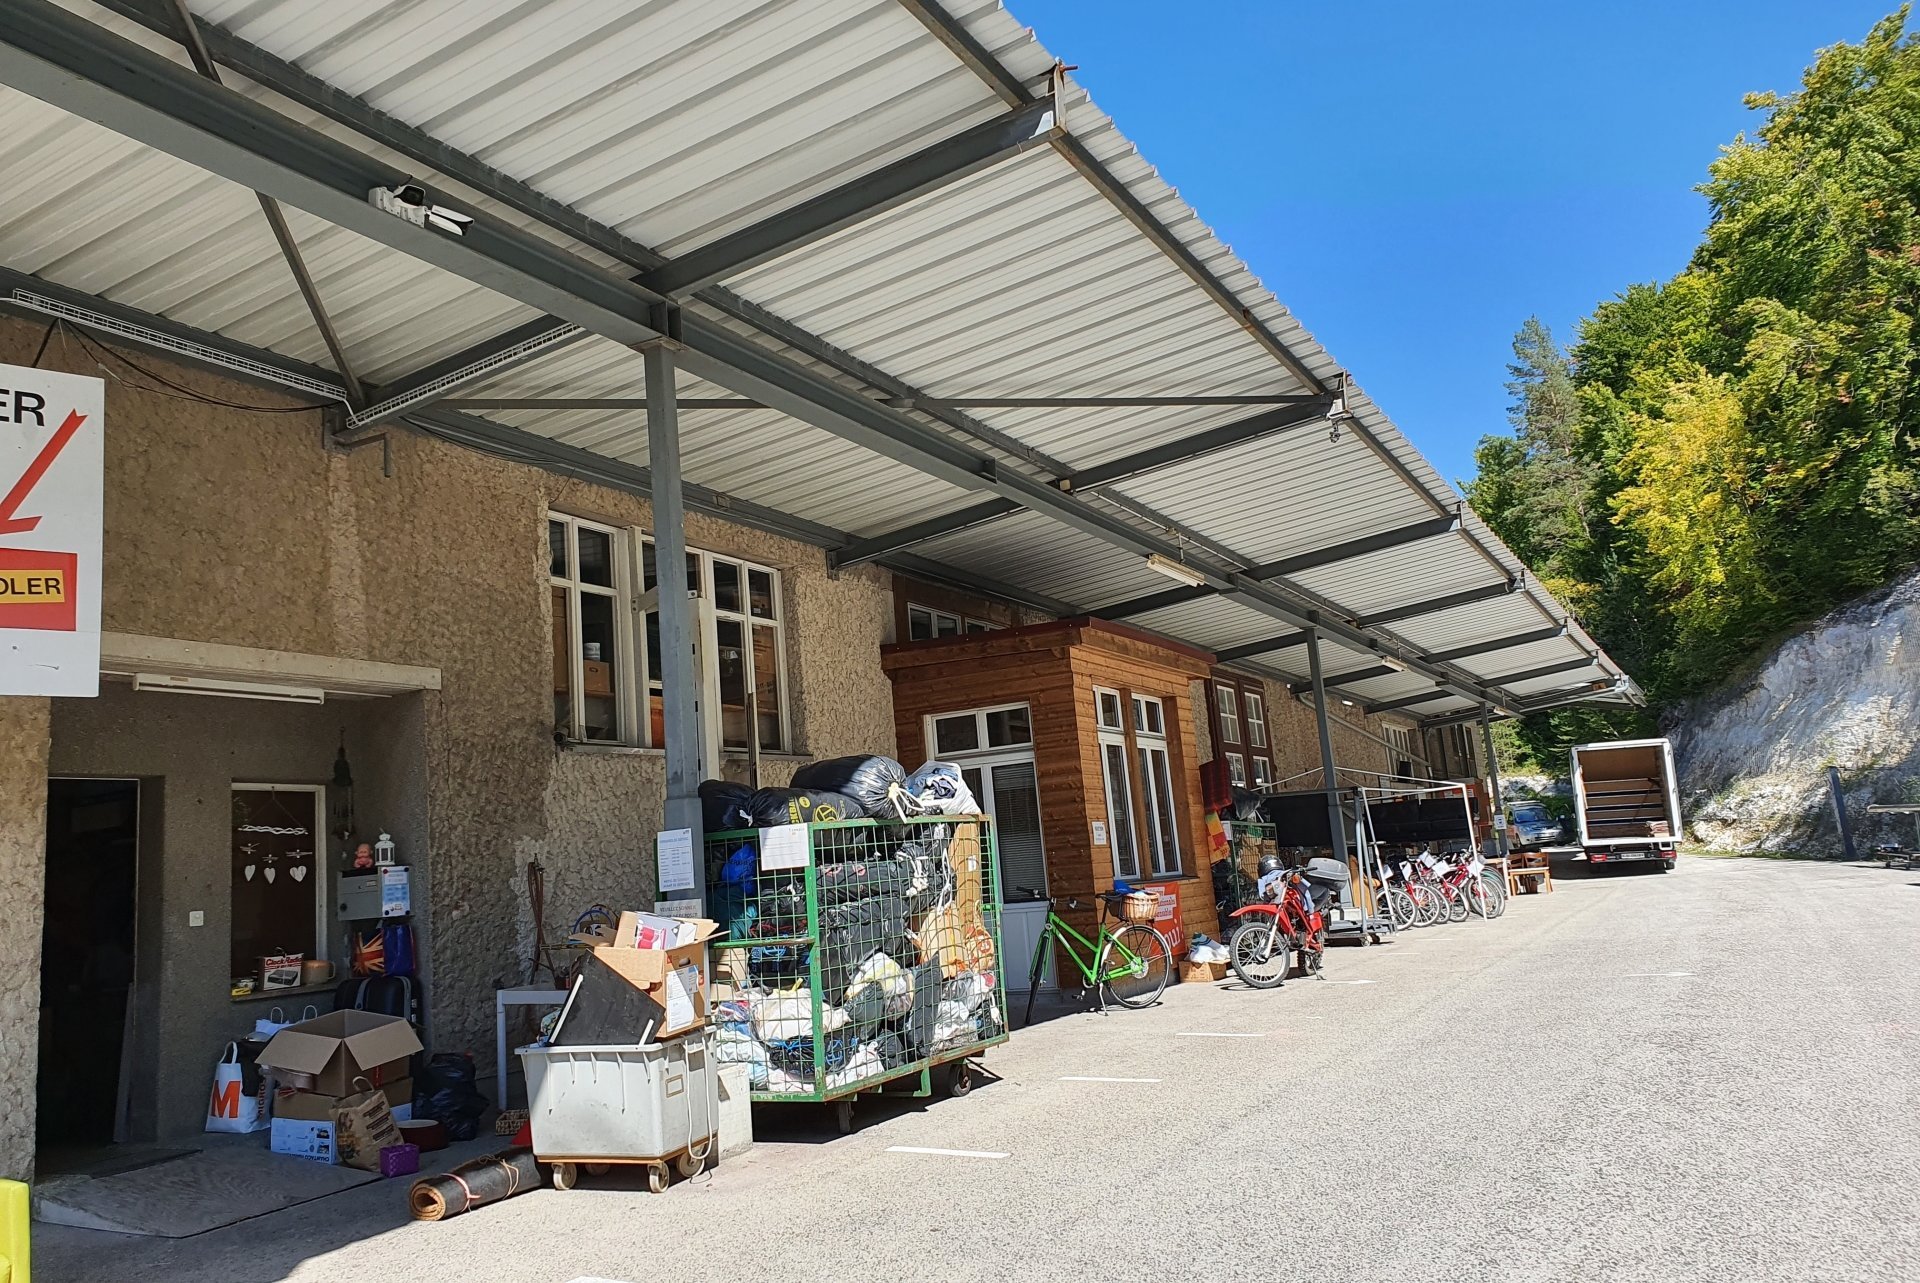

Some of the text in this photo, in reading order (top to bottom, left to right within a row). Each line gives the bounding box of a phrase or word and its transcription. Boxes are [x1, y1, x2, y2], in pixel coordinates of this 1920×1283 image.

[266, 956, 303, 966] Clock Radio
[211, 1080, 241, 1118] M
